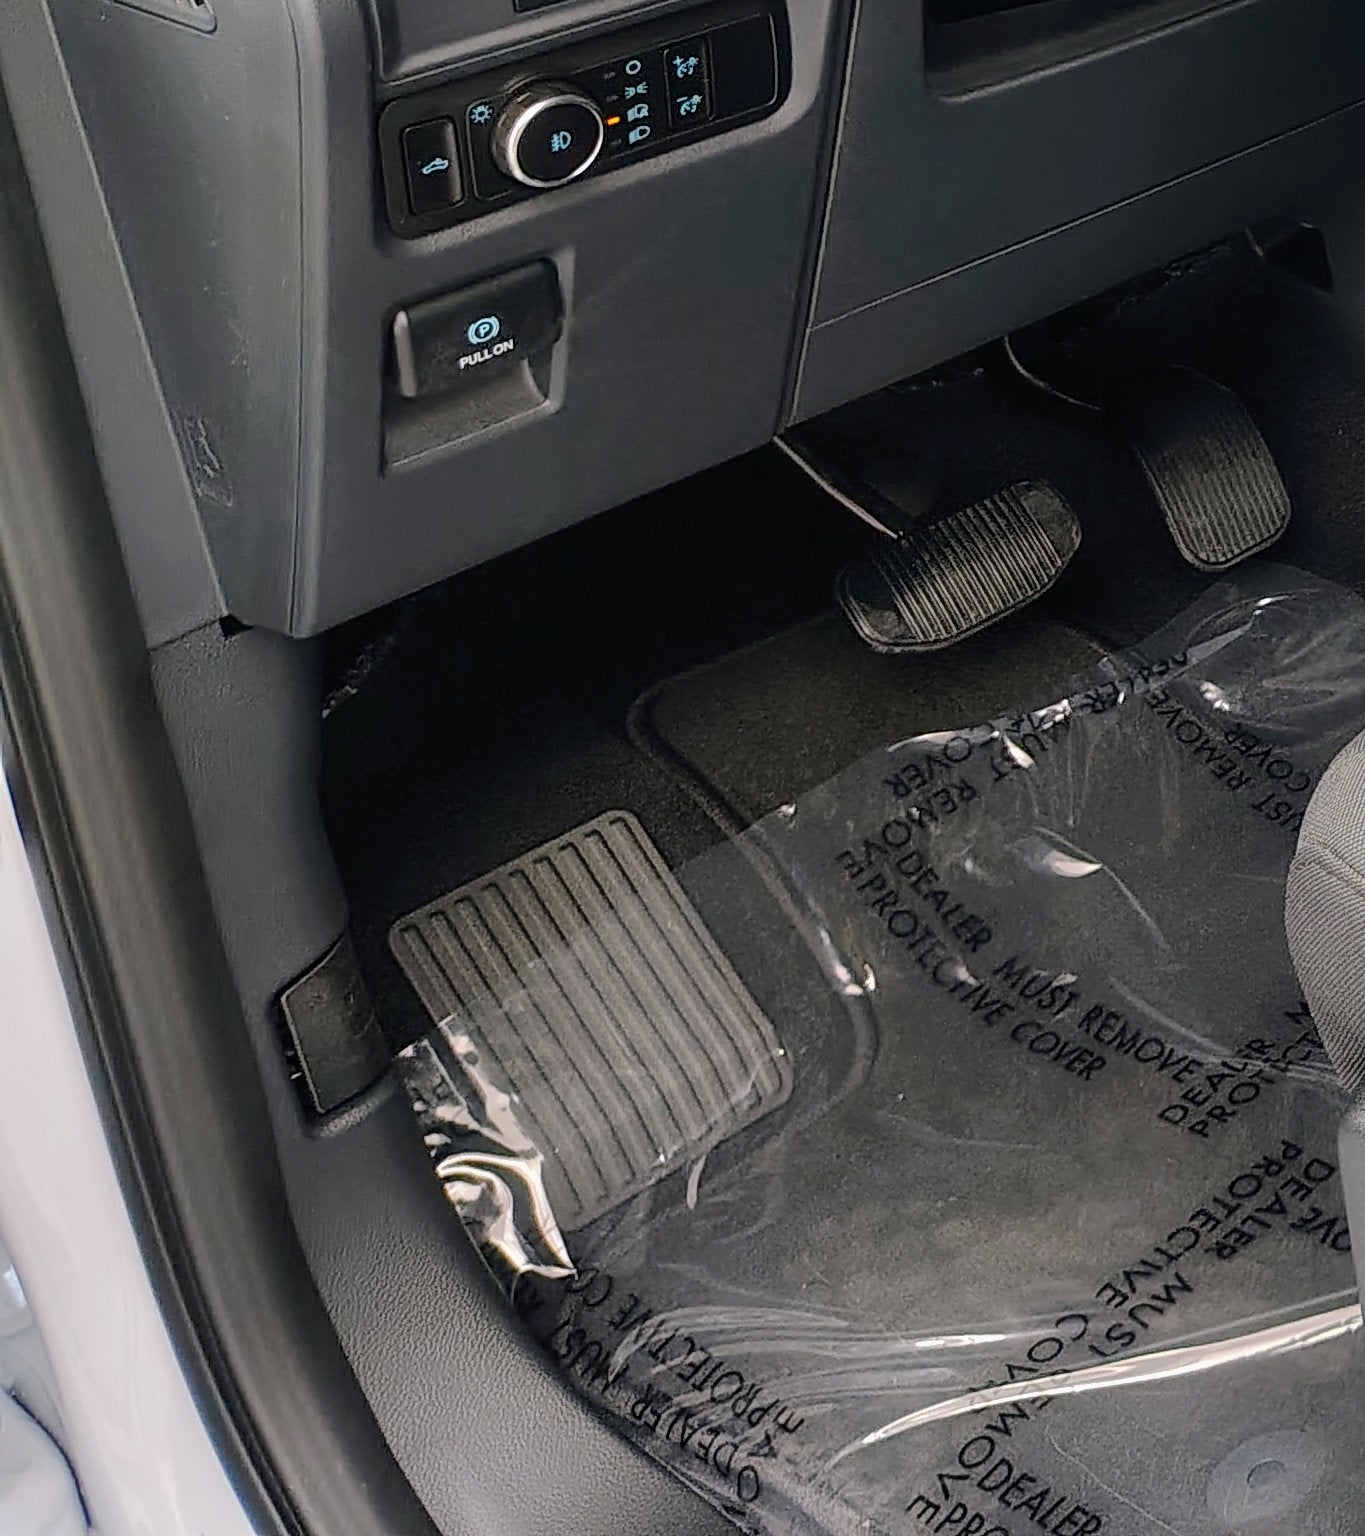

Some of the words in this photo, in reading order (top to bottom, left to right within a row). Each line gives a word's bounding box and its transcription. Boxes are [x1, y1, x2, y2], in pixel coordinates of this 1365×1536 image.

[459, 349, 493, 369] PULL
[492, 339, 514, 356] ON
[1145, 689, 1251, 792] REMOVE
[1224, 722, 1311, 793] COVER
[856, 872, 1015, 1028] PROTECTIVE
[1010, 1021, 1108, 1082] COVER
[896, 851, 993, 953] DEALER
[993, 954, 1081, 1016] MUST
[1078, 1004, 1205, 1084] REMOVE
[1095, 1139, 1303, 1309] PROTECTIVE
[1204, 1158, 1336, 1261] DEALER
[976, 1457, 1104, 1536] DEALER
